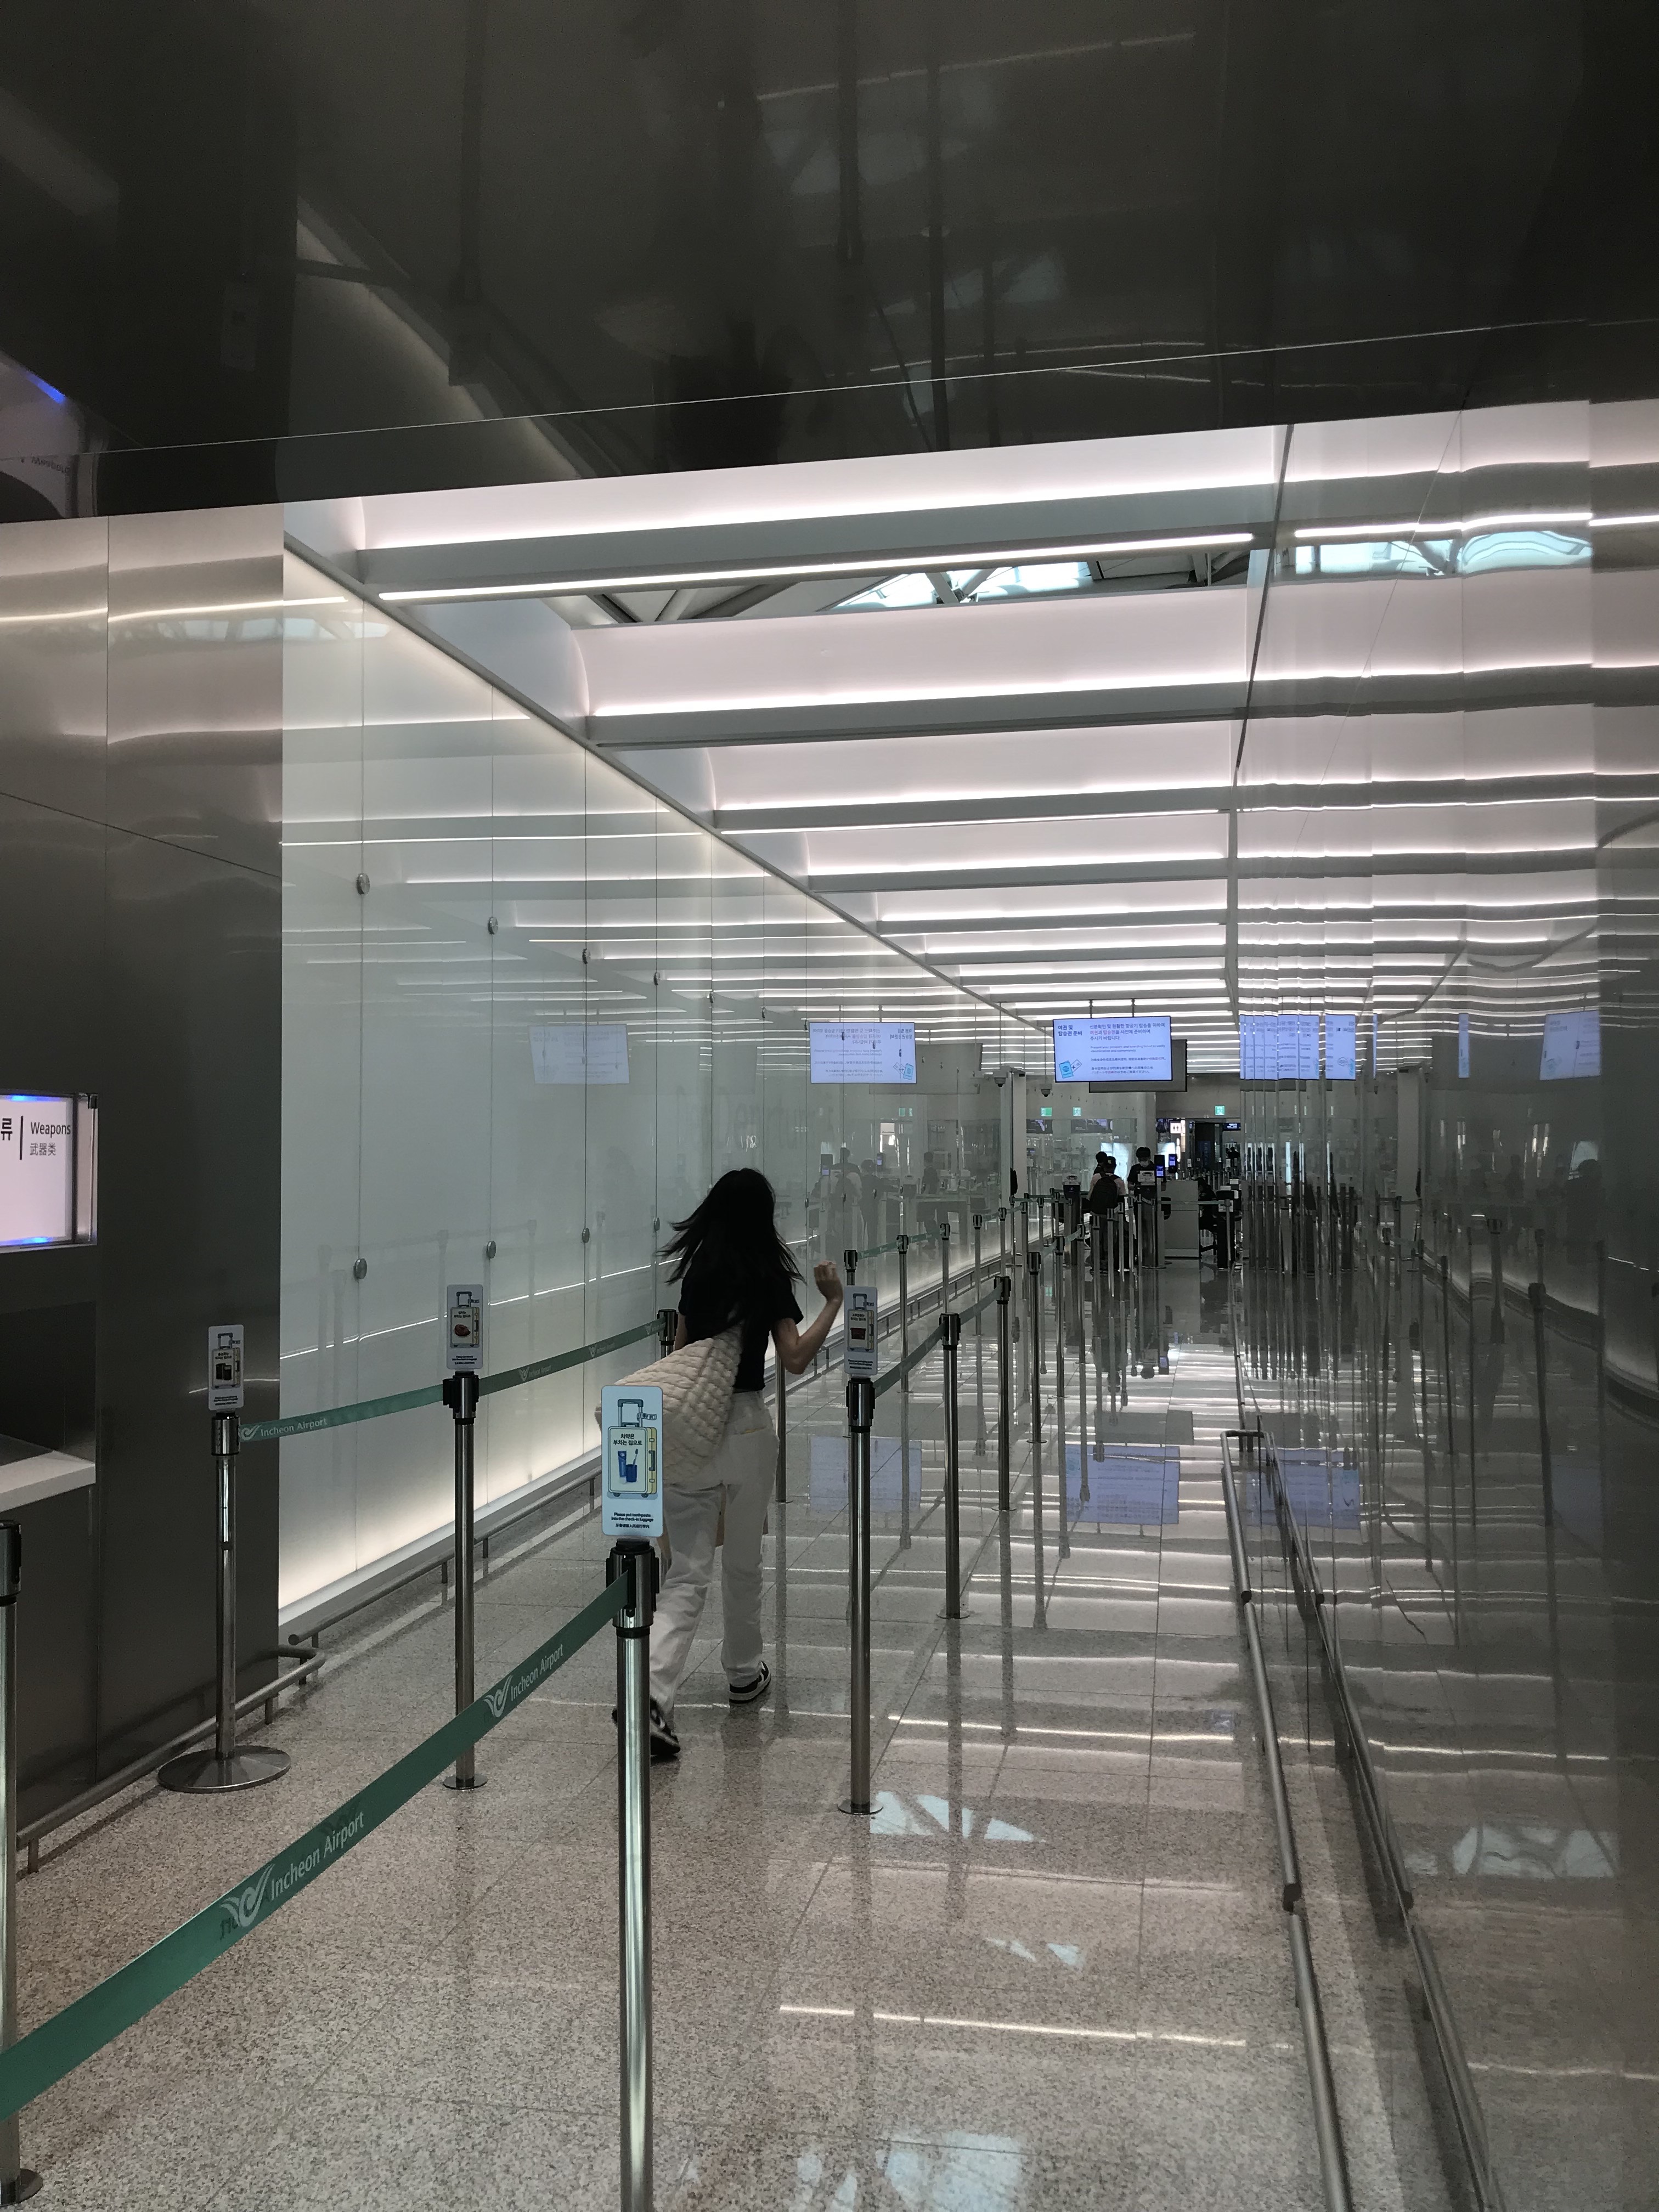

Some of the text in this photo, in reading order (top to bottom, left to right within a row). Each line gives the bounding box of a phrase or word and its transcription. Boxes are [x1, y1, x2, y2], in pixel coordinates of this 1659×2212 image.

[1, 1118, 13, 1141] 류
[30, 1122, 71, 1138] Weapons
[30, 1142, 57, 1156] 武器类
[261, 1418, 328, 1436] Incheon Airport
[511, 1644, 563, 1701] Incheon Airport
[272, 1812, 364, 1901] Incheon Airport
